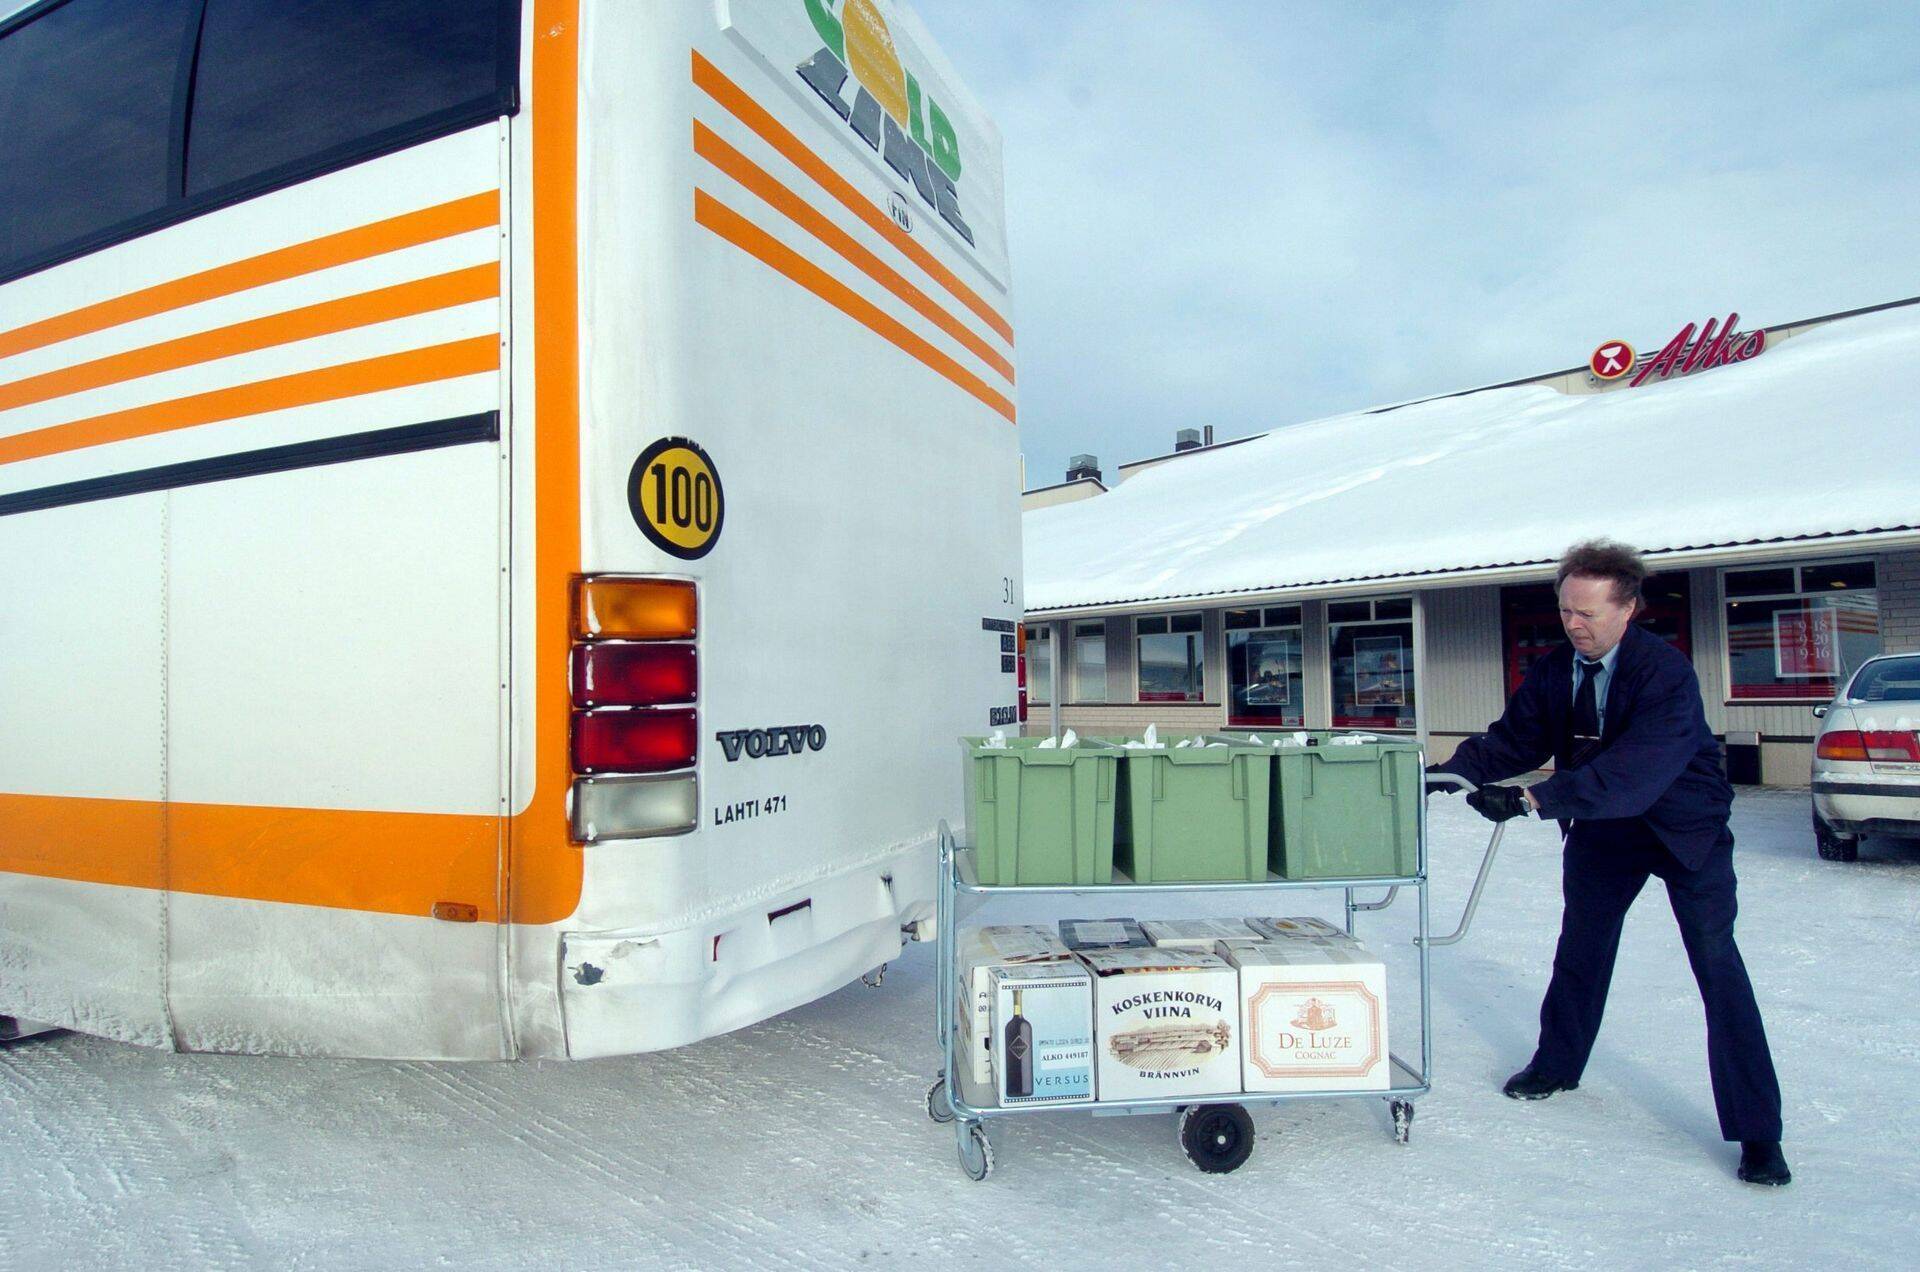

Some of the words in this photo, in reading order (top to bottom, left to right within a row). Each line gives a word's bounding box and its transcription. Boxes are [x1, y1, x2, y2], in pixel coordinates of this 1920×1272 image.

[796, 47, 976, 249] LINE
[1629, 312, 1767, 388] Alko
[651, 464, 712, 532] 100
[1003, 577, 1014, 604] 31
[716, 724, 827, 762] VOLVO
[714, 799, 760, 826] LAHTI
[764, 794, 788, 815] 471
[1111, 990, 1223, 1015] KOSKENKORVA
[1143, 1006, 1191, 1020] VIINA
[1041, 1054, 1063, 1063] ALKO
[1035, 1074, 1089, 1086] VERSUS
[1139, 1067, 1200, 1080] BRÄNNVIN
